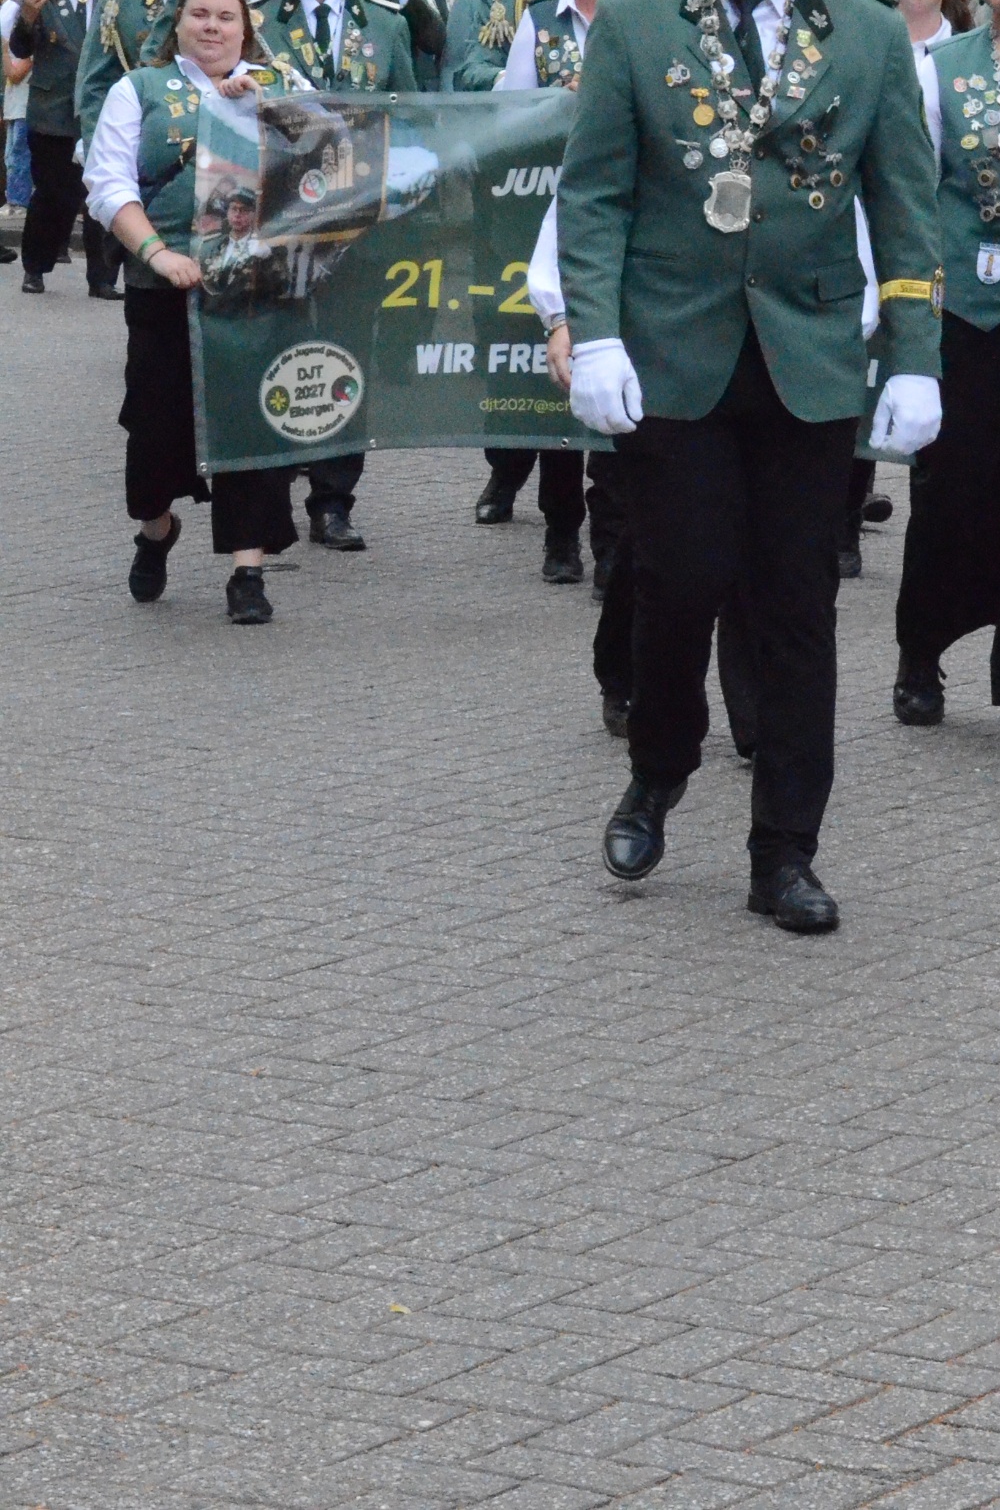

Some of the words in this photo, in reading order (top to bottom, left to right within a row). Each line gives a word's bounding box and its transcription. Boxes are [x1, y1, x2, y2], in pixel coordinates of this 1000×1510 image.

[491, 165, 564, 197] JUN
[294, 346, 325, 357] Jugend
[416, 342, 476, 374] WIR
[488, 342, 549, 374] FRE
[297, 364, 324, 381] DJT
[295, 383, 327, 401] 2027
